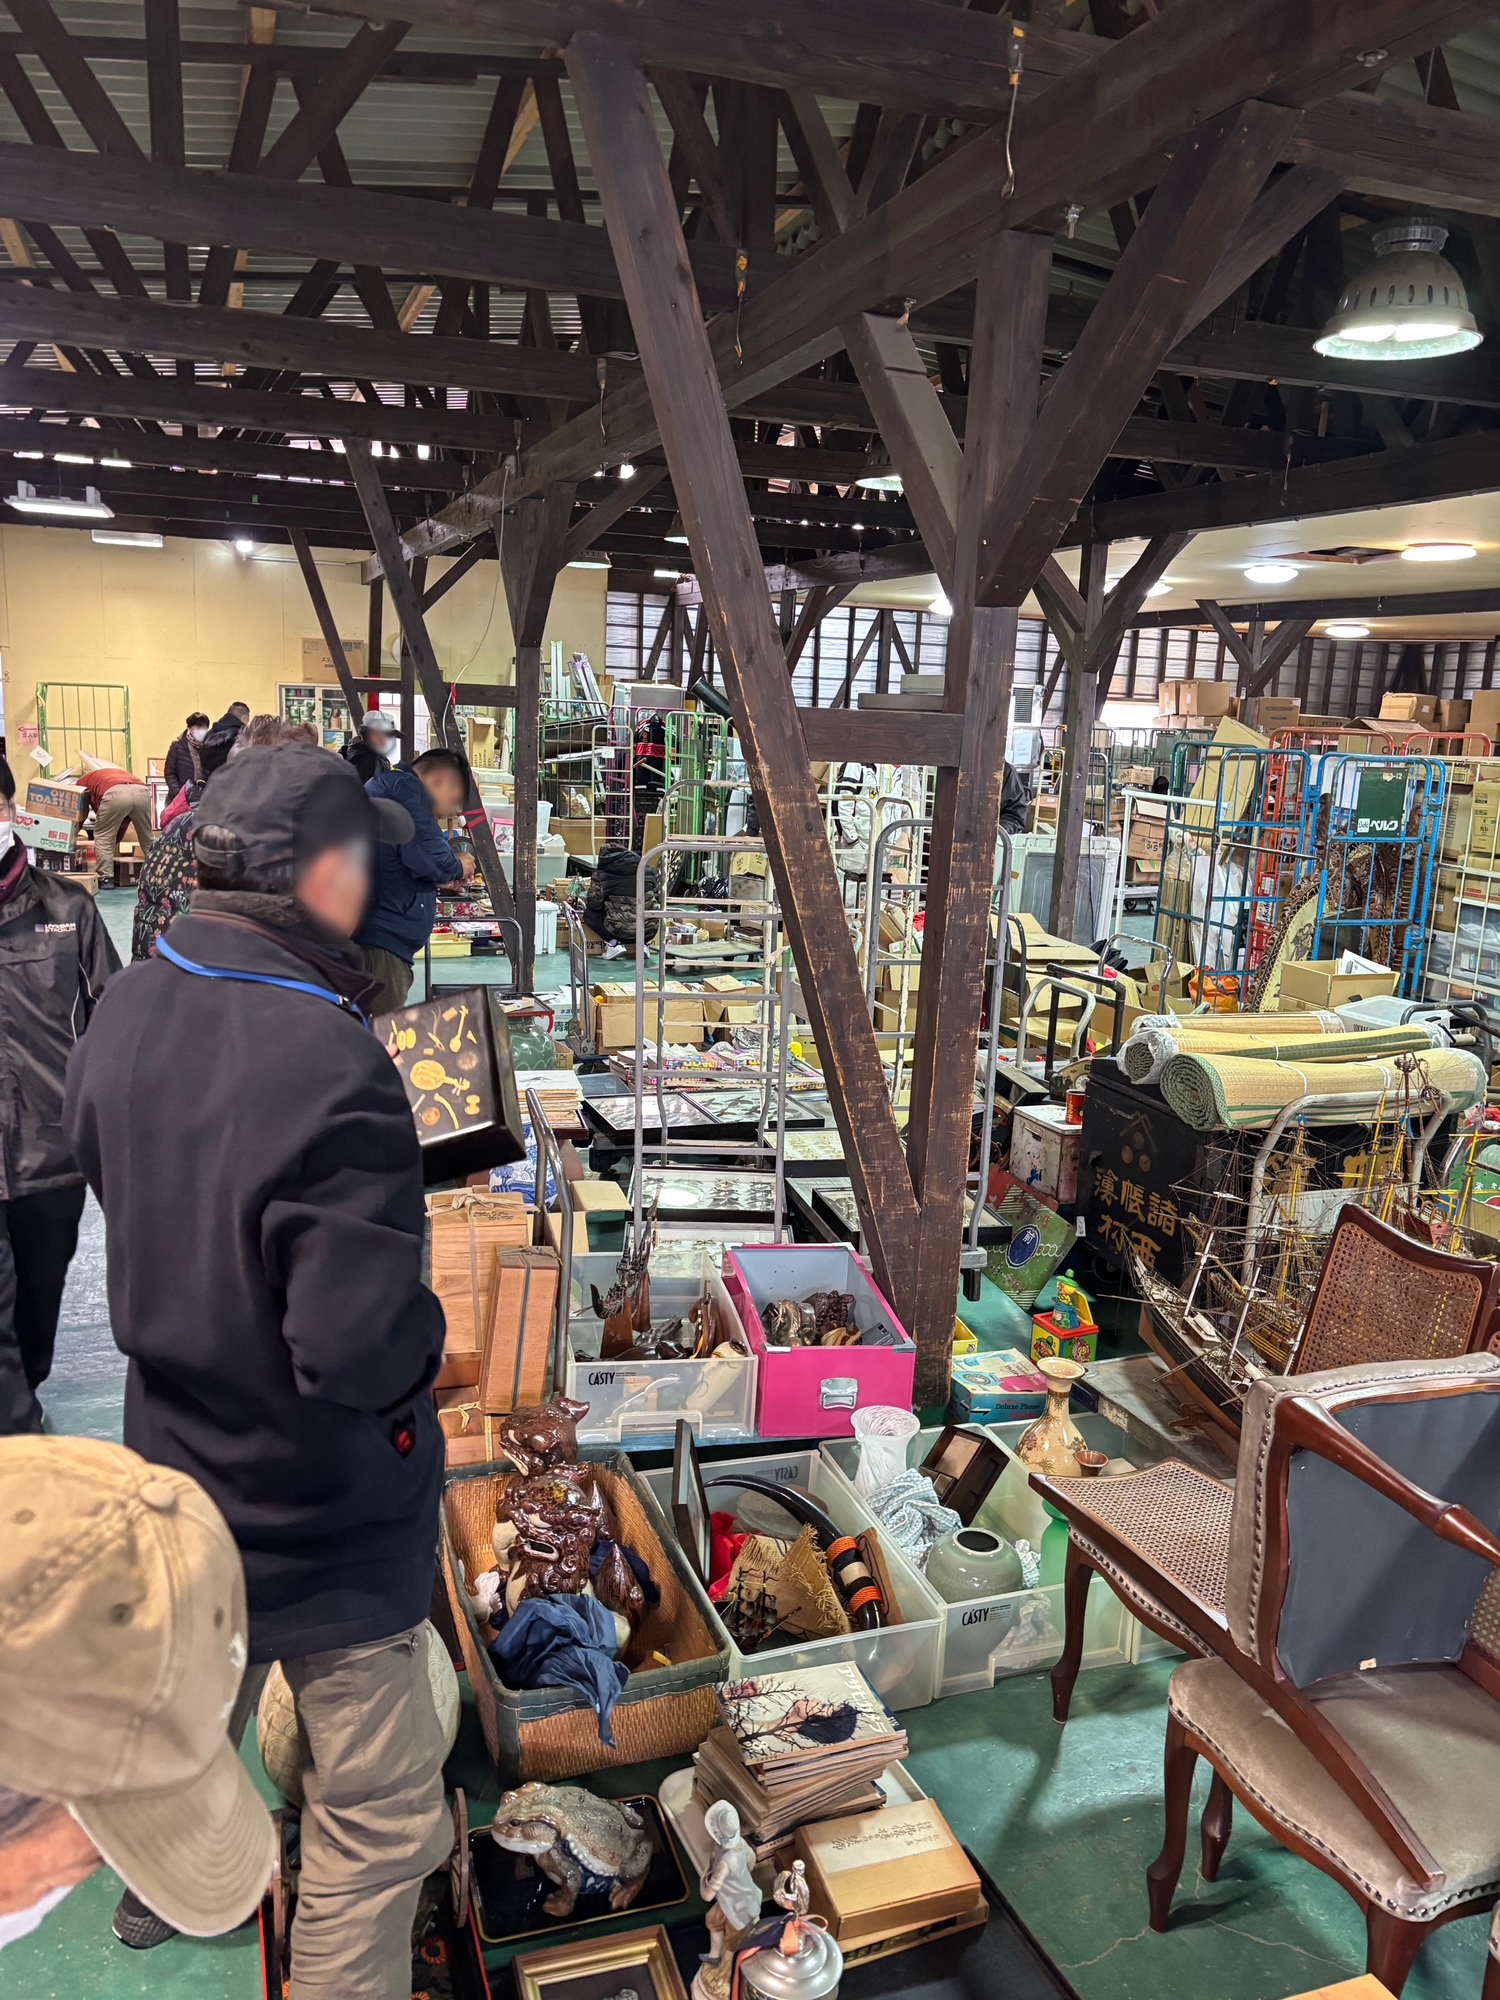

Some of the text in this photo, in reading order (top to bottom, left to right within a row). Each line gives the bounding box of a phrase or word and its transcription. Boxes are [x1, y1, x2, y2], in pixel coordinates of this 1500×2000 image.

[29, 792, 79, 809] TOASTER
[51, 788, 79, 801] OVEN
[1370, 820, 1399, 831] ベルク
[1020, 1402, 1040, 1410] Phone
[836, 1664, 889, 1735] アサヒカメラ
